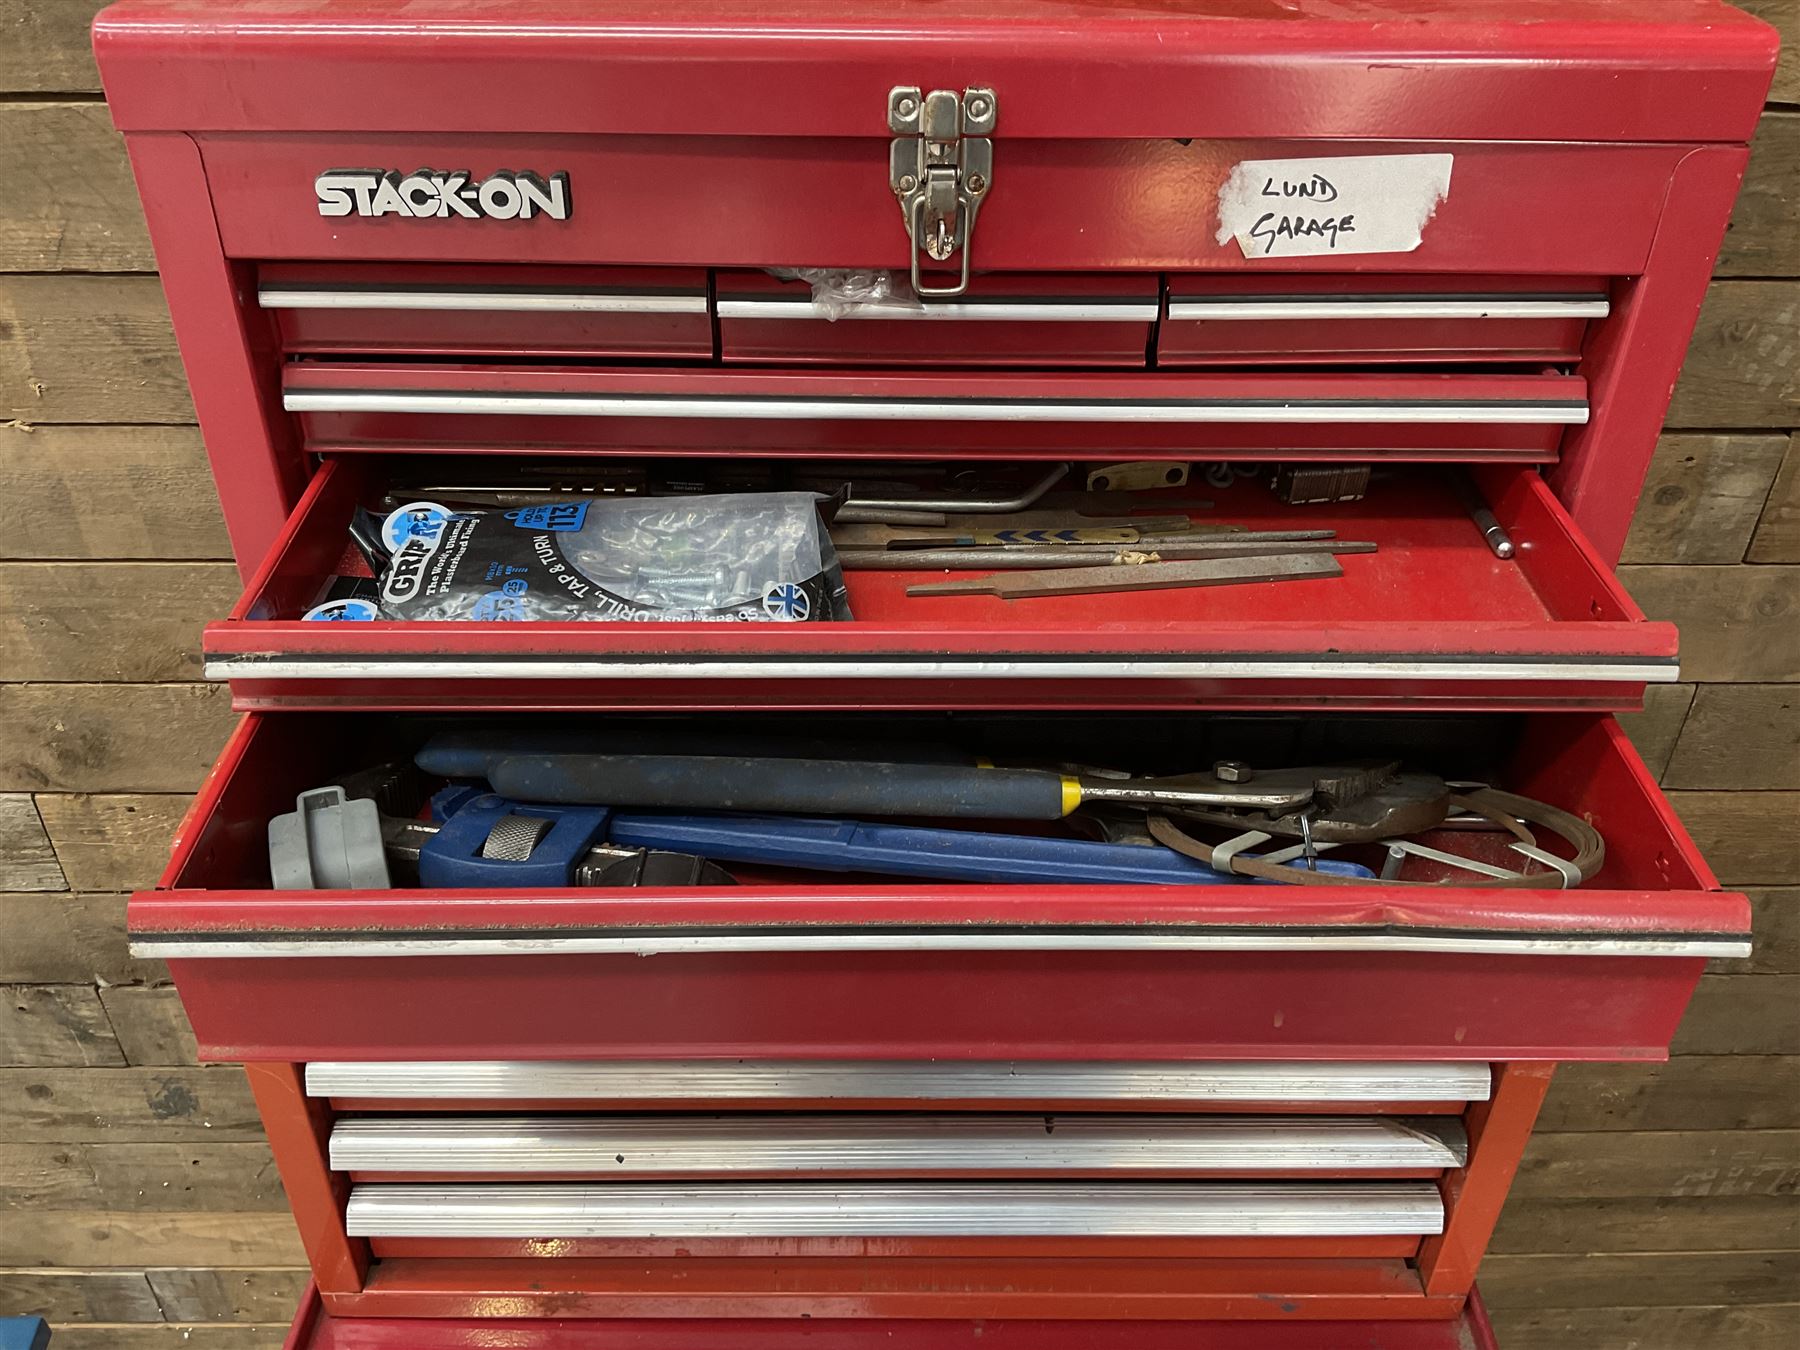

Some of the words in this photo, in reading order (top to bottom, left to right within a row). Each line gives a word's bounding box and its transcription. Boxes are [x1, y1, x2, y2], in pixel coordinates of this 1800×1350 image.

[315, 173, 567, 220] STACK-ON
[1261, 174, 1338, 202] LUND
[1250, 212, 1356, 253] GARAGE
[547, 506, 579, 529] 113
[431, 550, 453, 576] World's
[440, 540, 468, 594] Plasterboard
[460, 519, 481, 541] Fixing
[532, 534, 553, 567] TURN
[549, 560, 566, 574] &
[426, 575, 439, 596] The
[556, 573, 591, 599] TAP
[594, 590, 651, 622] DRILL,
